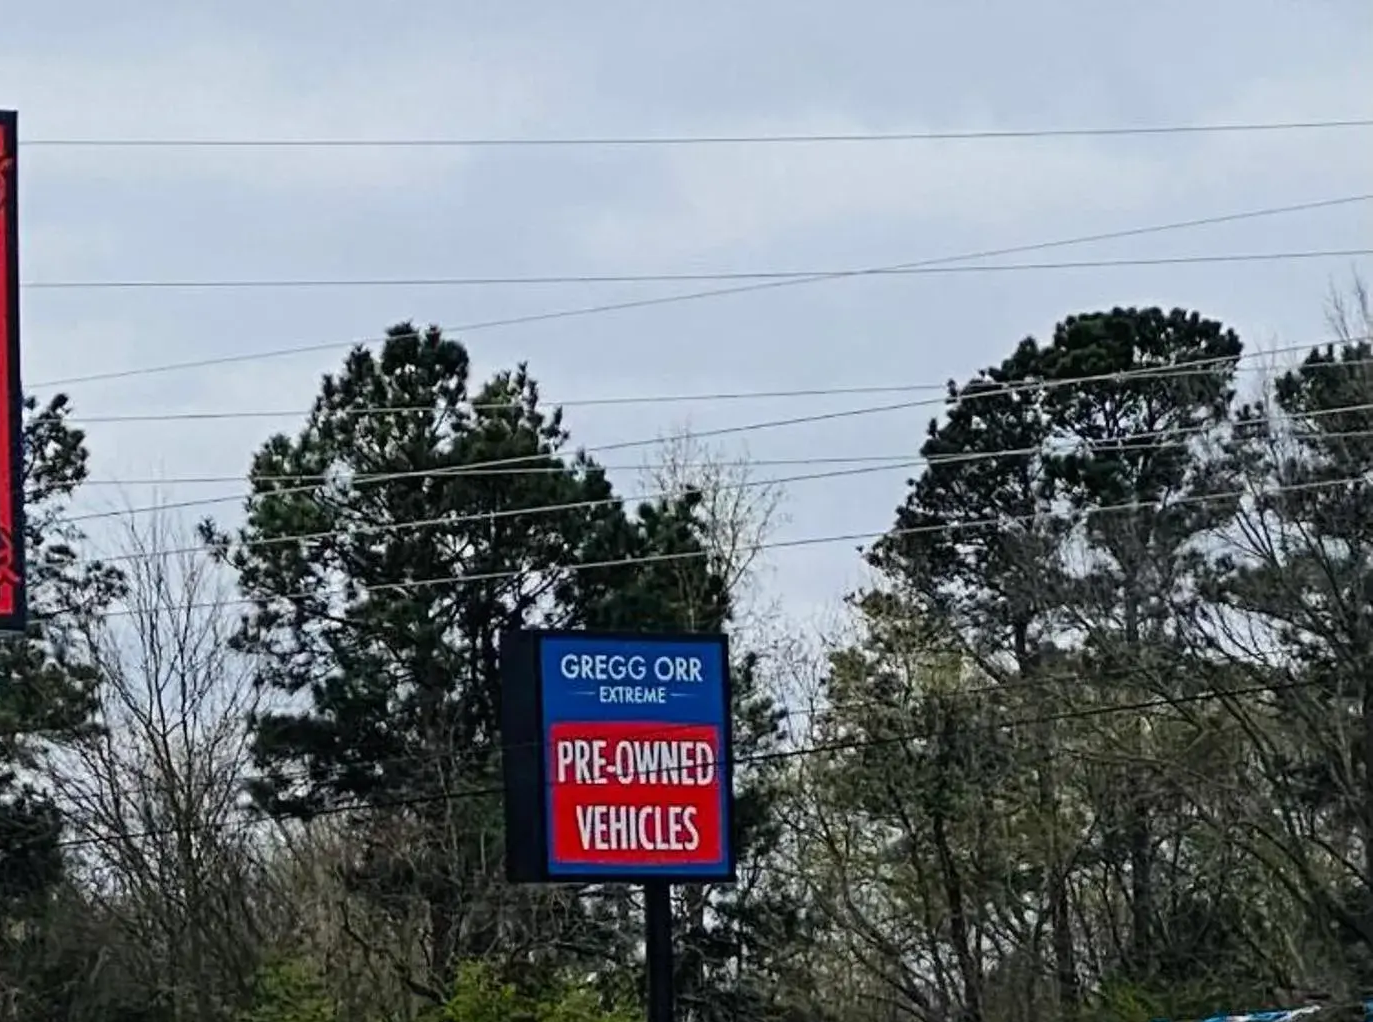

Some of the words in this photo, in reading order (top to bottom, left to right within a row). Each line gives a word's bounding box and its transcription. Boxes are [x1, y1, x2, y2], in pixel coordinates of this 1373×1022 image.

[561, 654, 647, 680] GREGG
[654, 656, 703, 682] ORR
[599, 686, 667, 704] EXTREME
[557, 740, 715, 785] PRE-OWNED
[576, 805, 699, 851] VEHICLES
